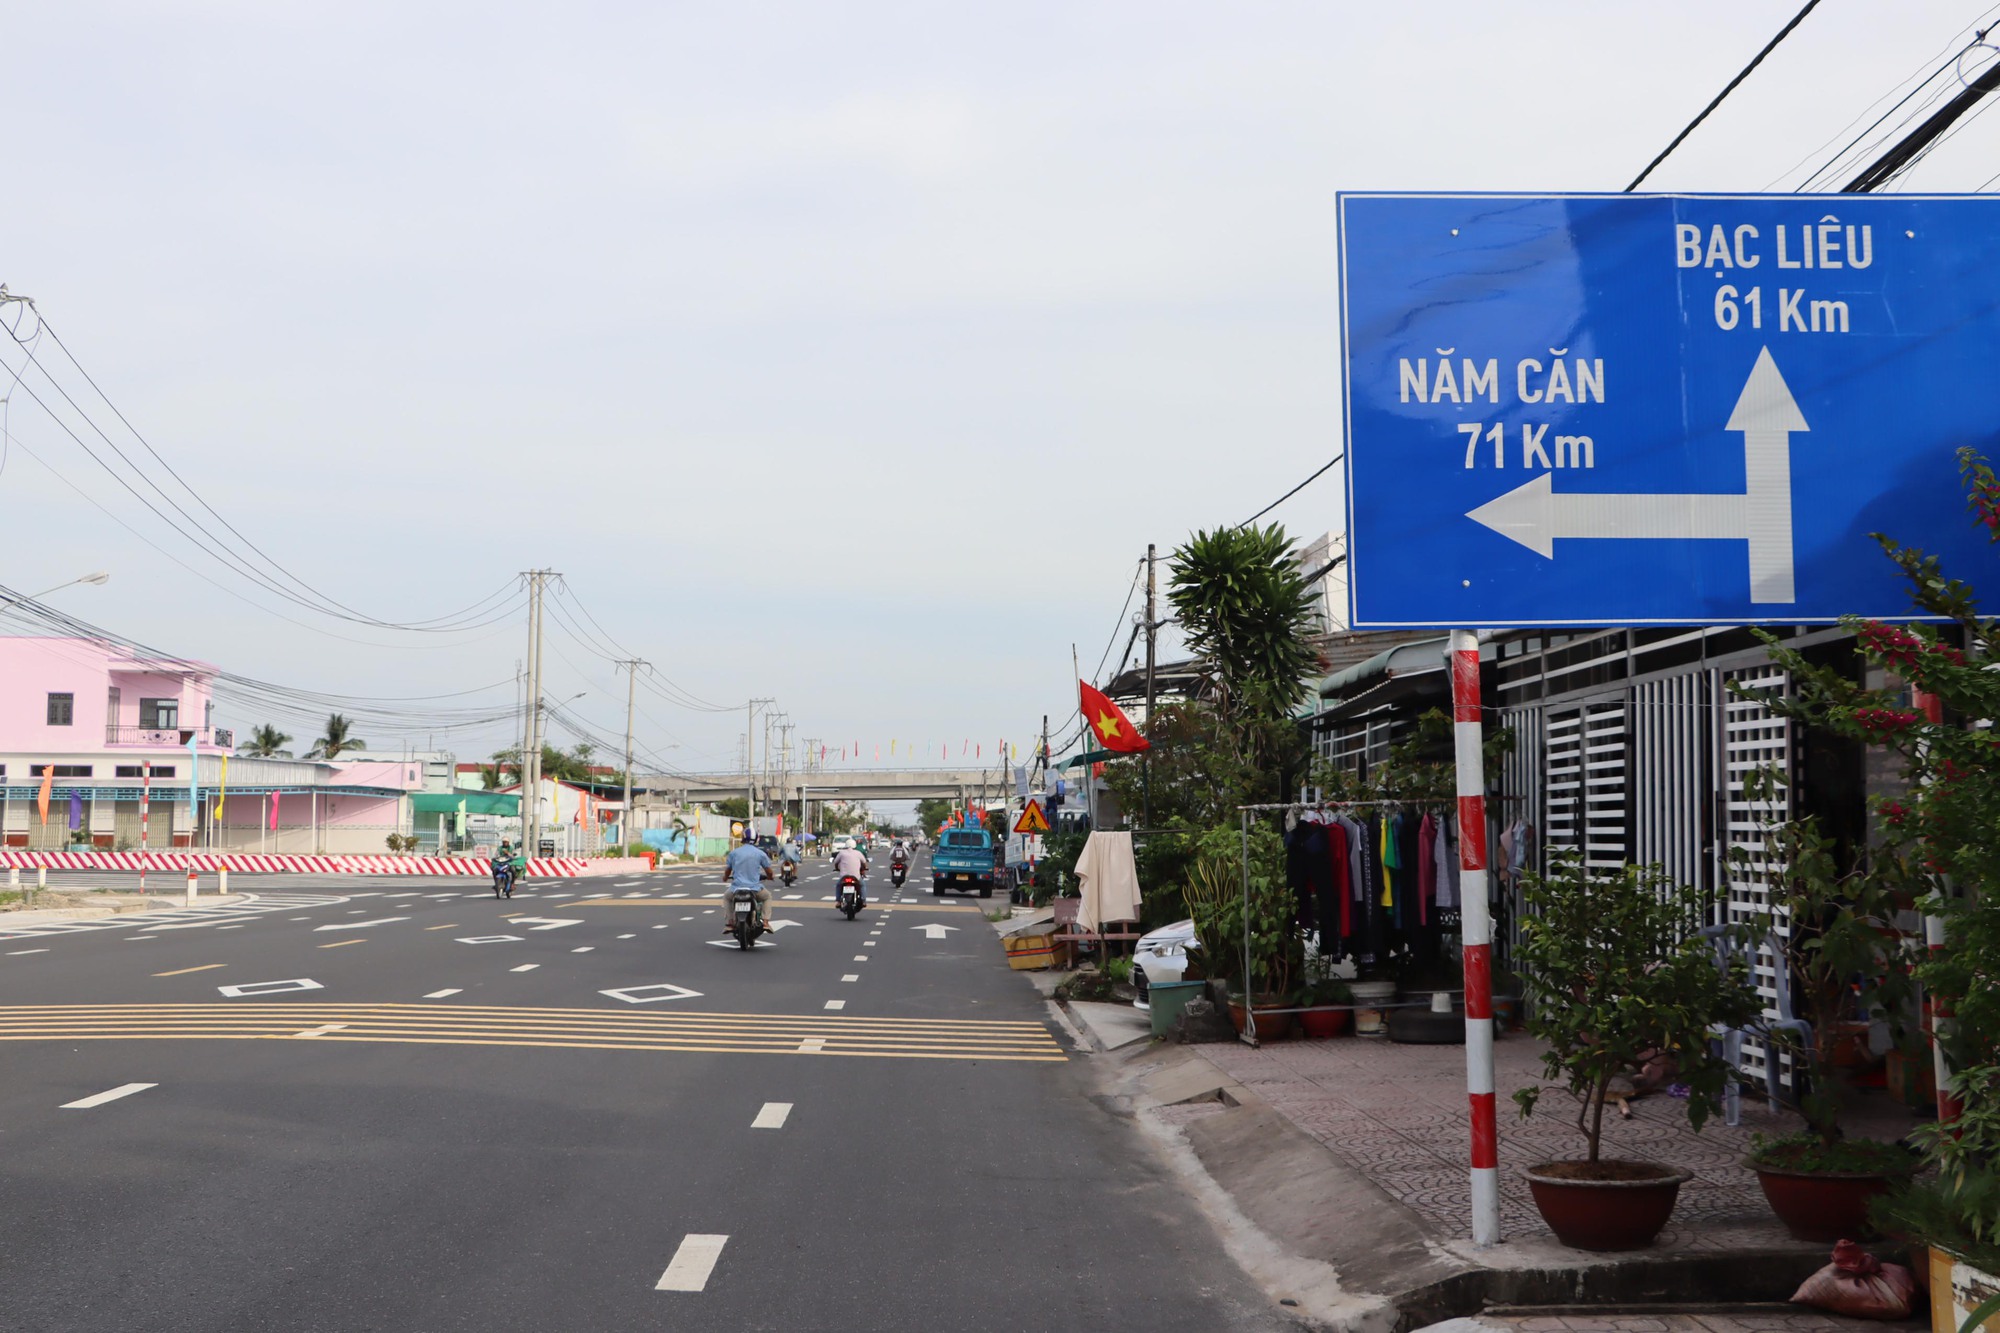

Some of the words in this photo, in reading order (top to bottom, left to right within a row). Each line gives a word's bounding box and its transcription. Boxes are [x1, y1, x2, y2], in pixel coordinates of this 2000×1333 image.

[1676, 224, 1760, 278] BẠC
[1777, 215, 1872, 269] LIÊU
[1715, 285, 1761, 331] 61
[1780, 288, 1849, 333] Km
[1399, 347, 1499, 403] NĂM
[1517, 347, 1605, 404] CĂN
[1457, 422, 1504, 469] 71
[1523, 423, 1594, 469] Km
